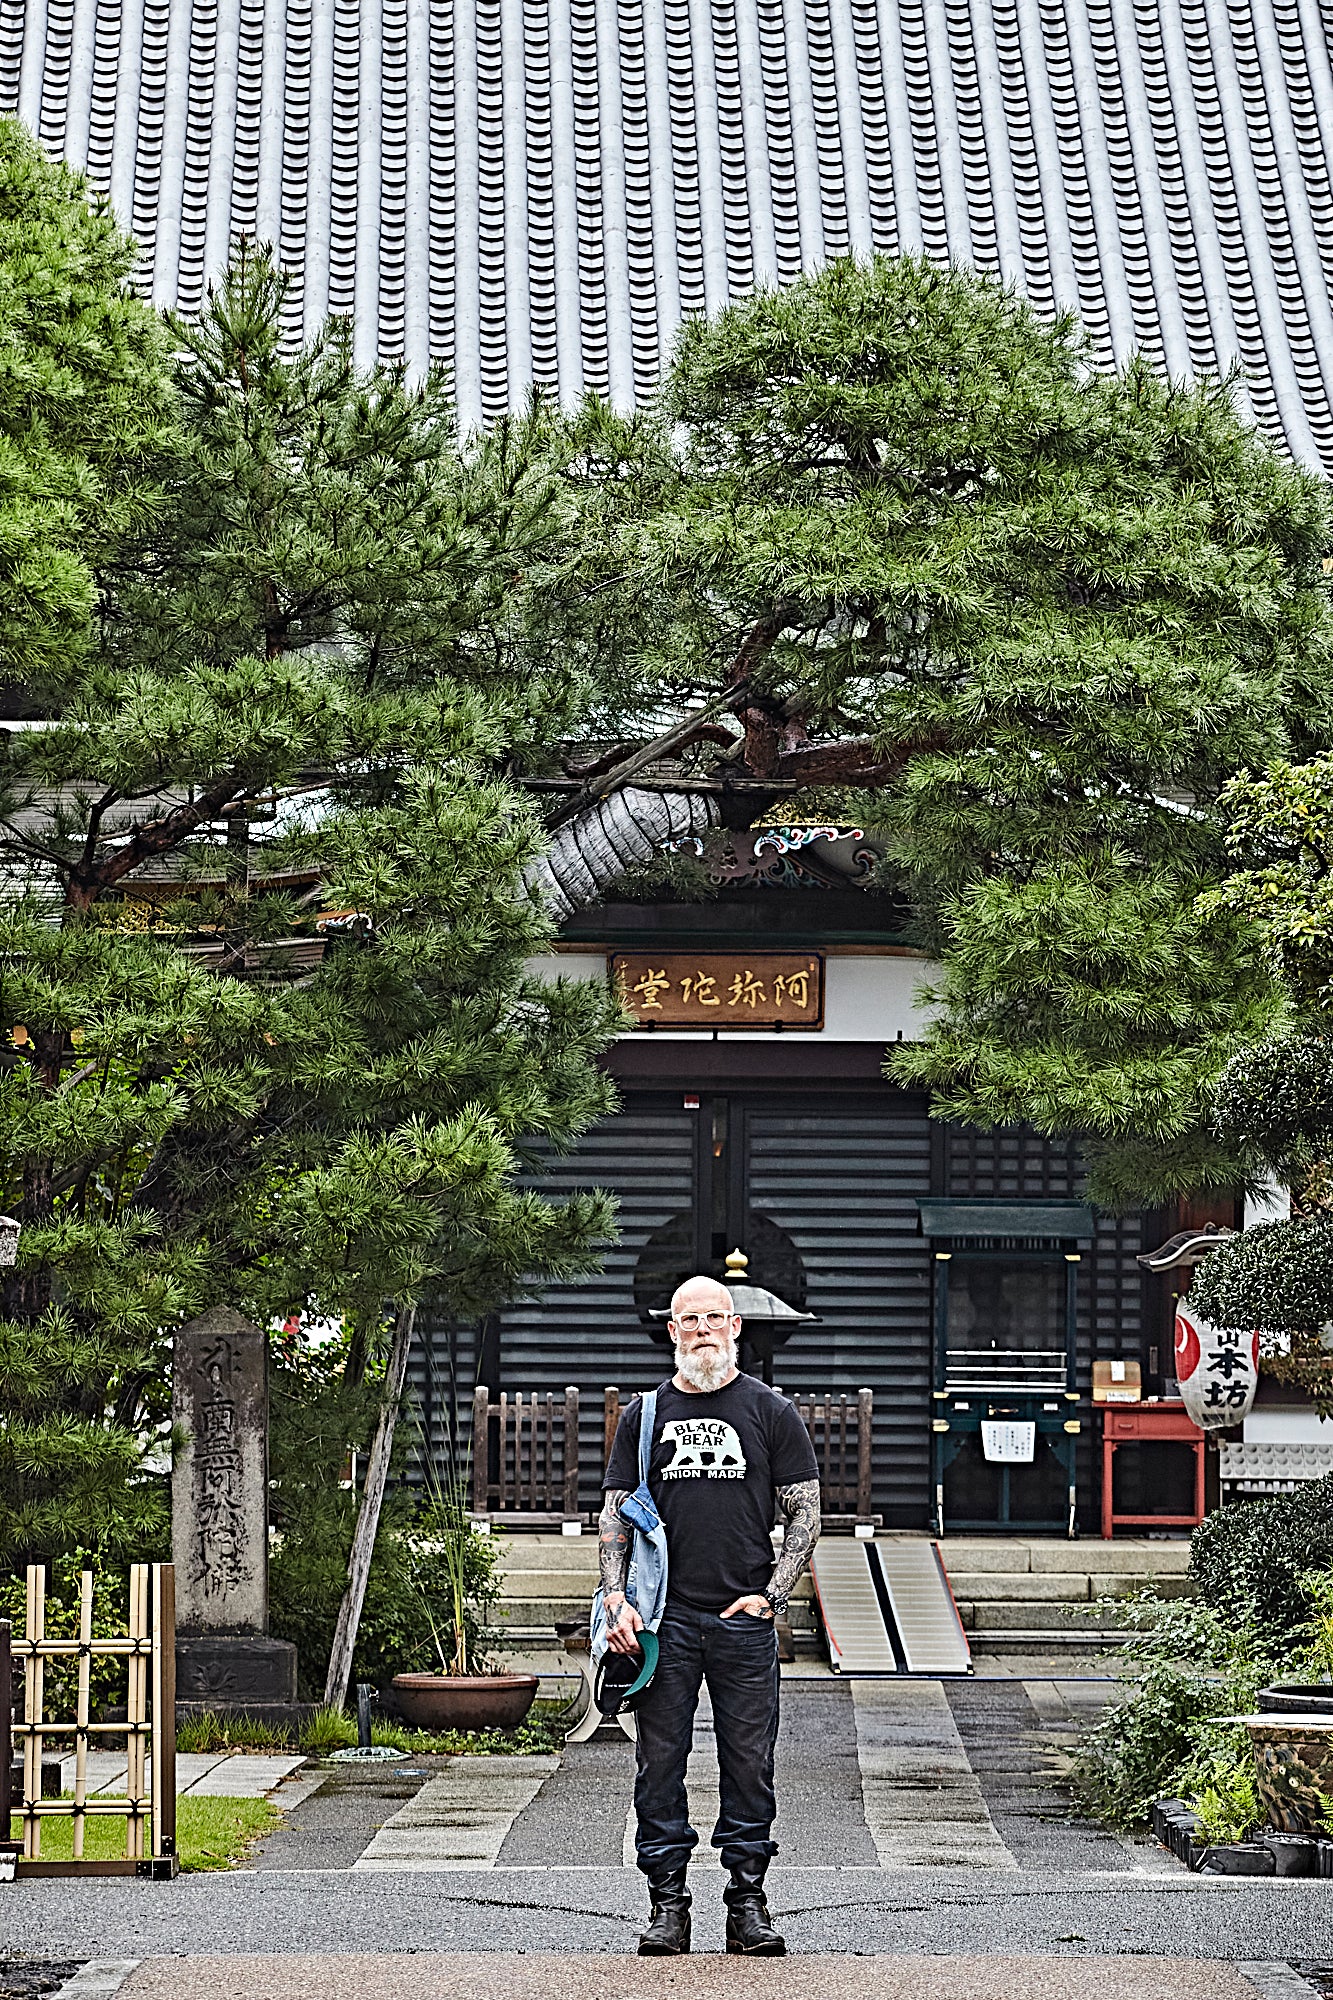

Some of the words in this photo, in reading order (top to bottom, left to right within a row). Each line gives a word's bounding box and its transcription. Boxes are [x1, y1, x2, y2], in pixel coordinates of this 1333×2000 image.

[673, 1422, 728, 1437] BLACK
[682, 1433, 723, 1446] BEAR
[662, 1469, 701, 1480] UNION
[707, 1469, 745, 1479] MADE
